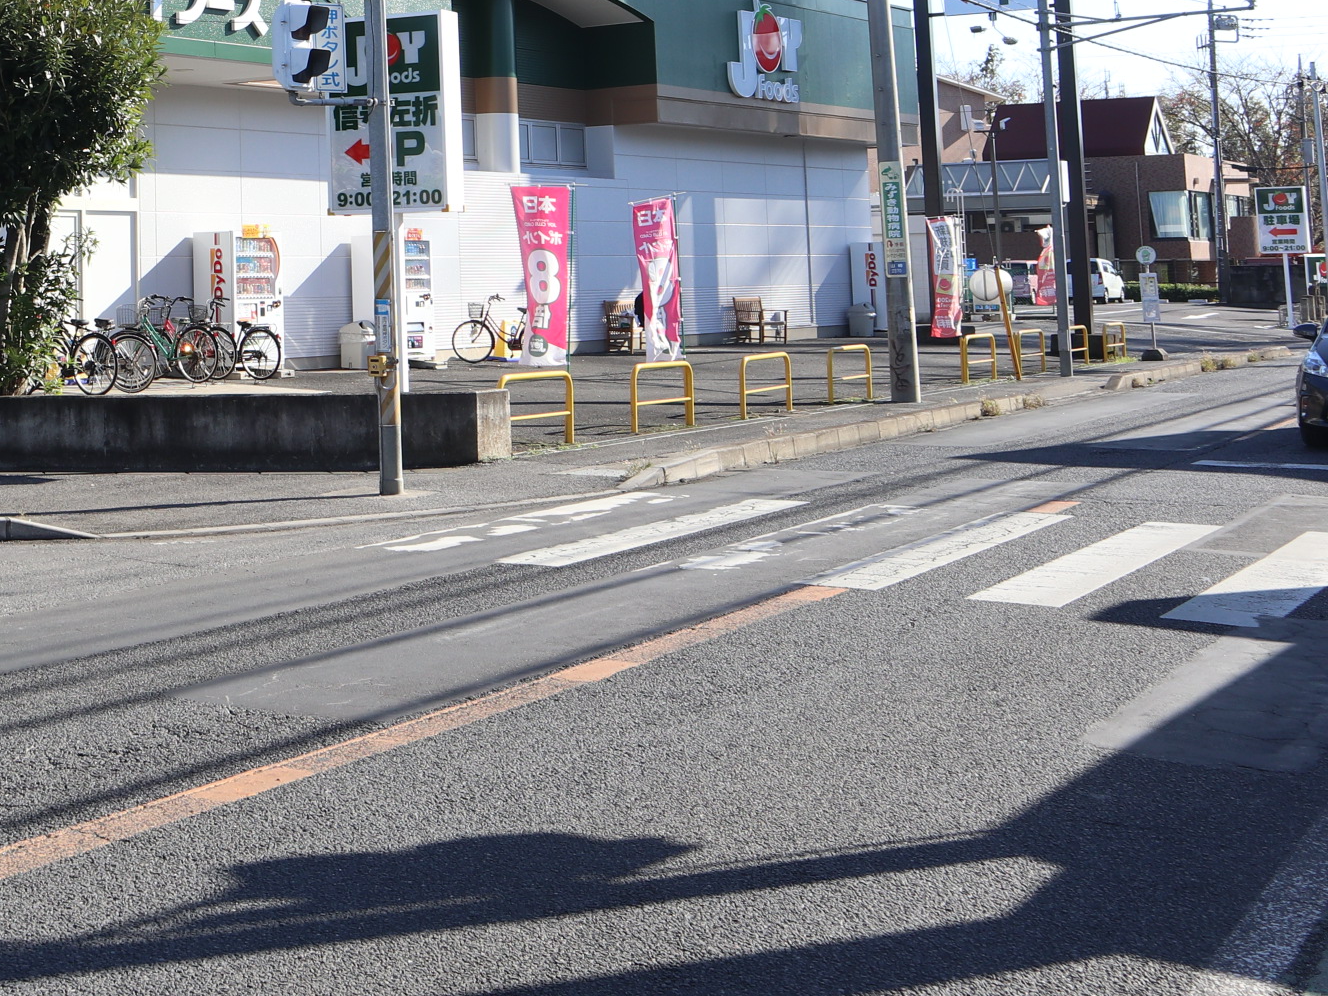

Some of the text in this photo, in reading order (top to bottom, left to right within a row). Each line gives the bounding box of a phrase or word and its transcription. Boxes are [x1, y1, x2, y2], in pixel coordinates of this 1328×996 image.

[396, 131, 426, 167] P
[360, 171, 418, 187] 営時間
[1263, 215, 1300, 226] 駐車場
[868, 253, 879, 288] DyDo
